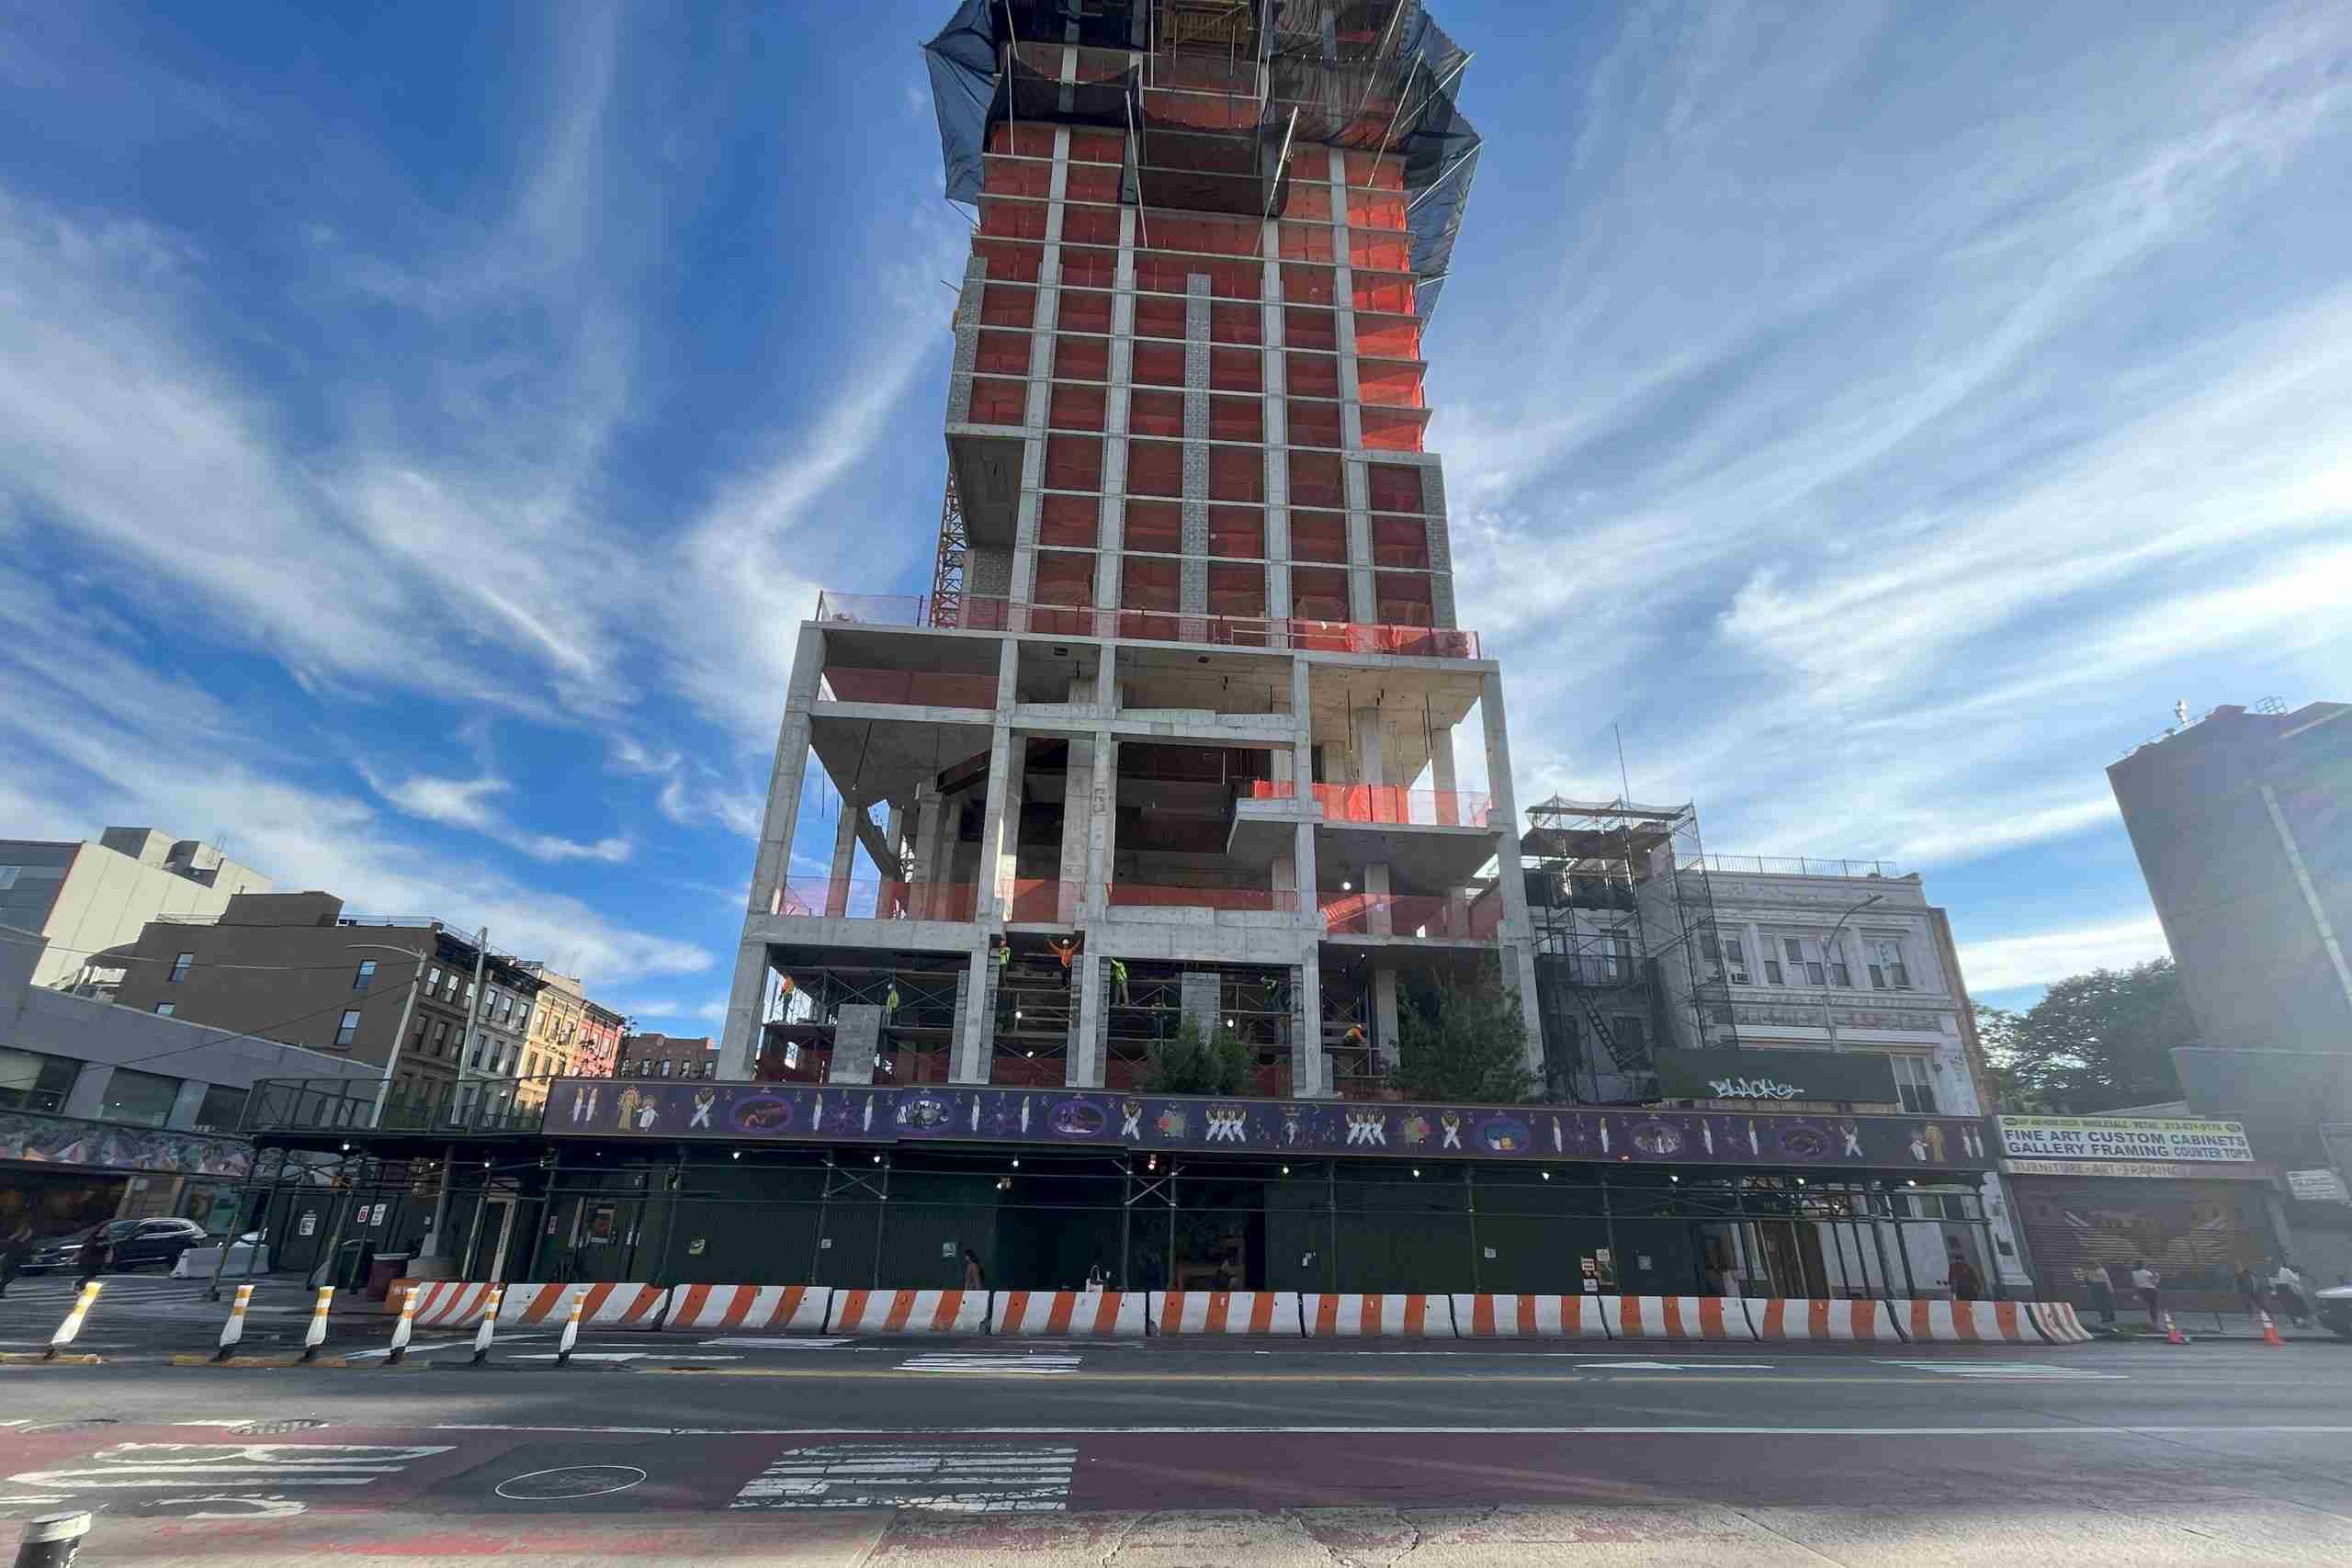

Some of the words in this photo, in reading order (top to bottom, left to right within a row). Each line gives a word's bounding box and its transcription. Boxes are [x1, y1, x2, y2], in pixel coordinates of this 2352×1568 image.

[2004, 1130, 2044, 1142] FINE
[2050, 1131, 2082, 1142] ART
[2087, 1131, 2165, 1145] CUSTOM
[2170, 1134, 2245, 1147] CABINETS
[2008, 1142, 2085, 1155] GALLERY
[2090, 1144, 2168, 1157] FRAMING
